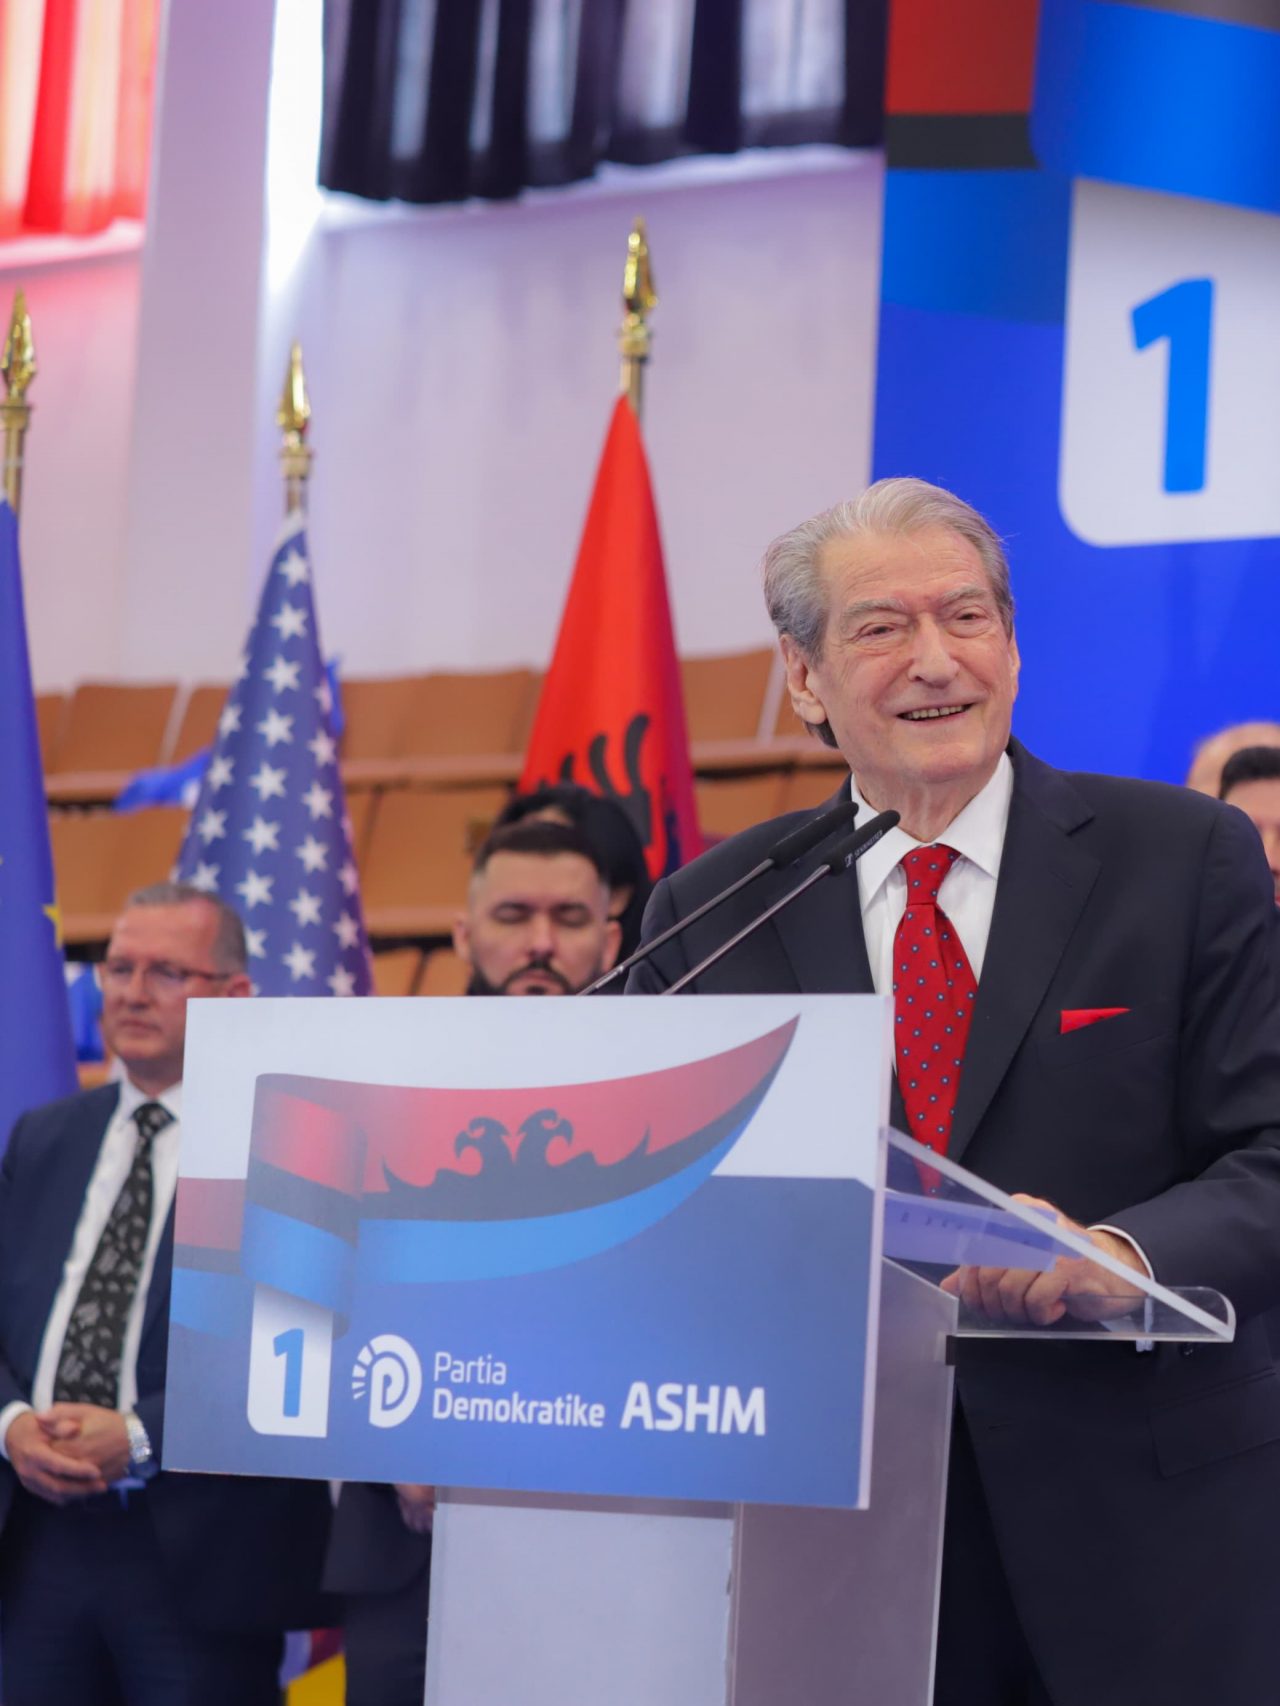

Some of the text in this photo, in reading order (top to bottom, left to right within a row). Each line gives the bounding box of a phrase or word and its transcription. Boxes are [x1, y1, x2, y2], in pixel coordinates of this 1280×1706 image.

[1130, 276, 1216, 496] 1
[272, 1327, 305, 1418] 1
[432, 1351, 508, 1385] Partia
[432, 1387, 606, 1429] Demokratike
[619, 1381, 767, 1436] ASHM
